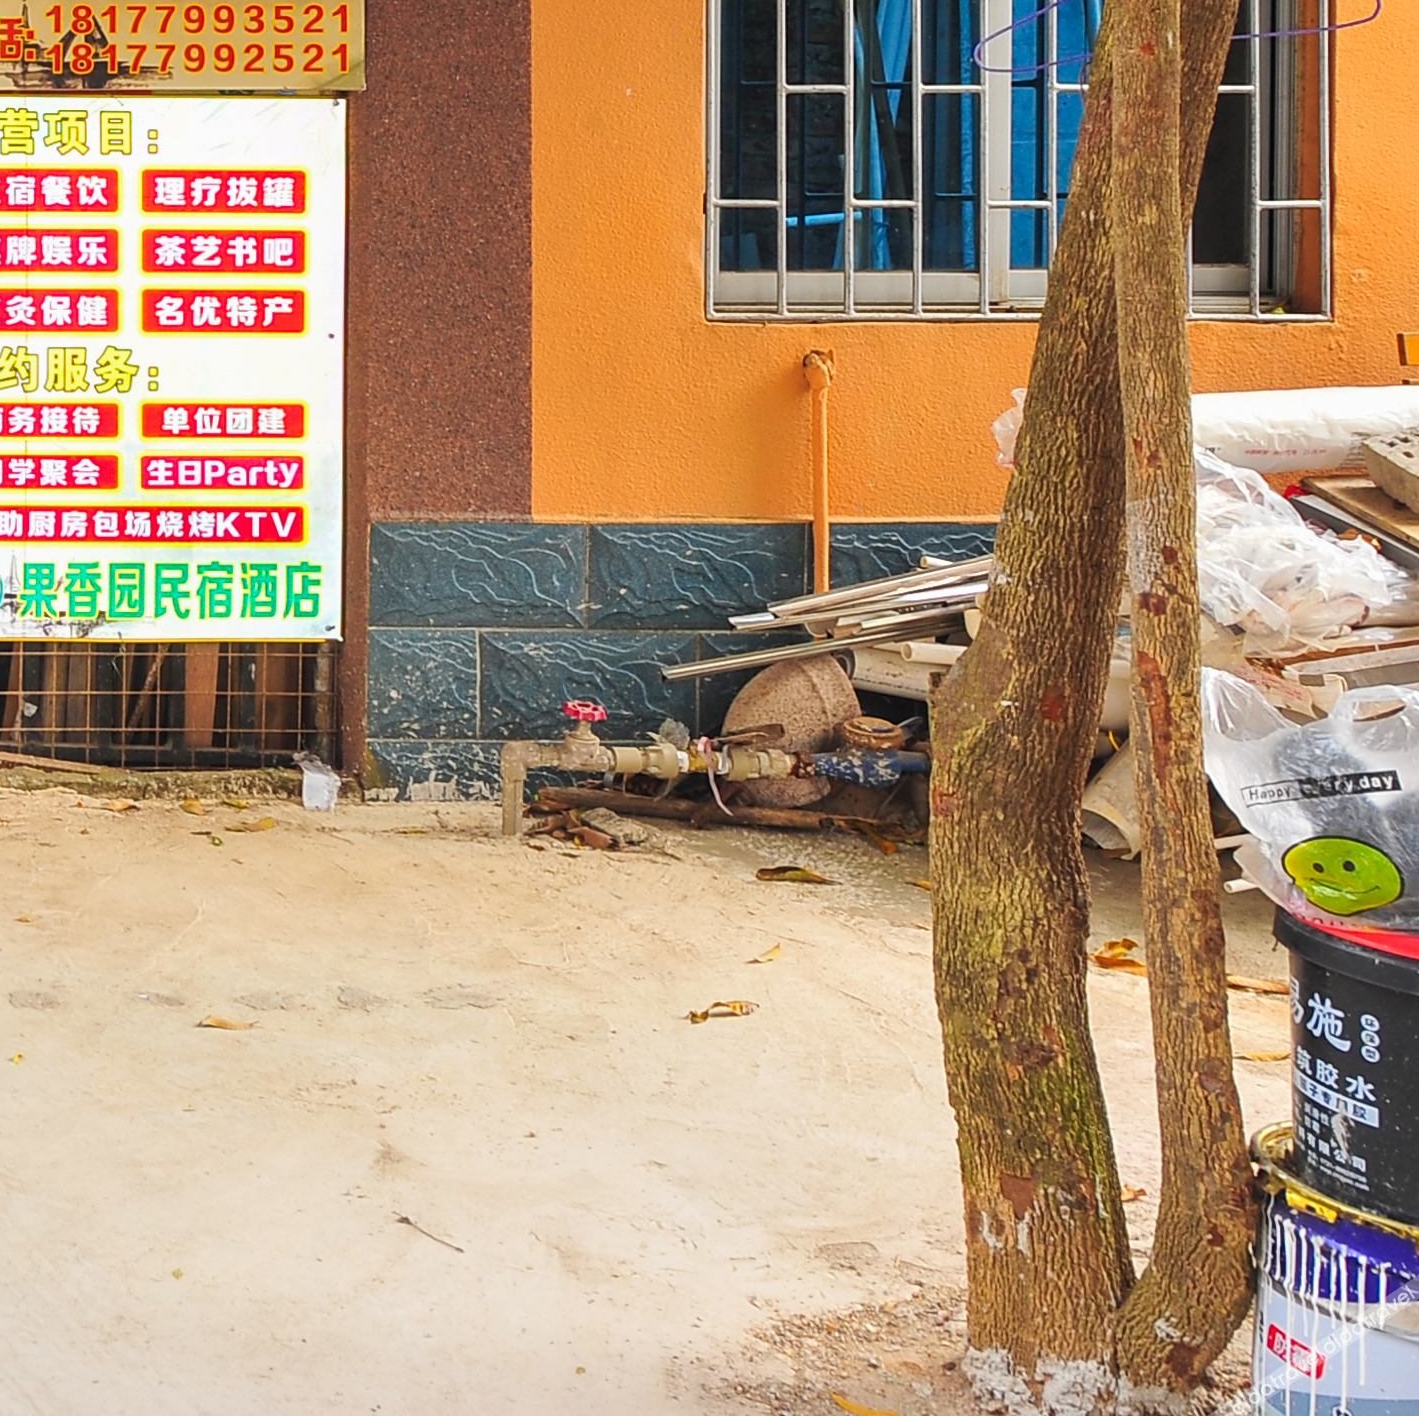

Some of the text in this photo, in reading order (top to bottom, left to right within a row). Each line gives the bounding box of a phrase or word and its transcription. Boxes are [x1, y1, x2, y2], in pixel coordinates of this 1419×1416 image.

[45, 3, 352, 36] 18177993521
[45, 42, 352, 75] 18177992521
[154, 176, 295, 209] 理疗拔罐
[154, 236, 295, 268] 茶艺书吧
[154, 296, 295, 328] 名优特产
[162, 406, 287, 436] 单位团建
[146, 458, 300, 488] 生日Party
[16, 560, 323, 622] 果香园民宿酒店
[1249, 786, 1291, 802] Happy
[1358, 775, 1394, 790] day
